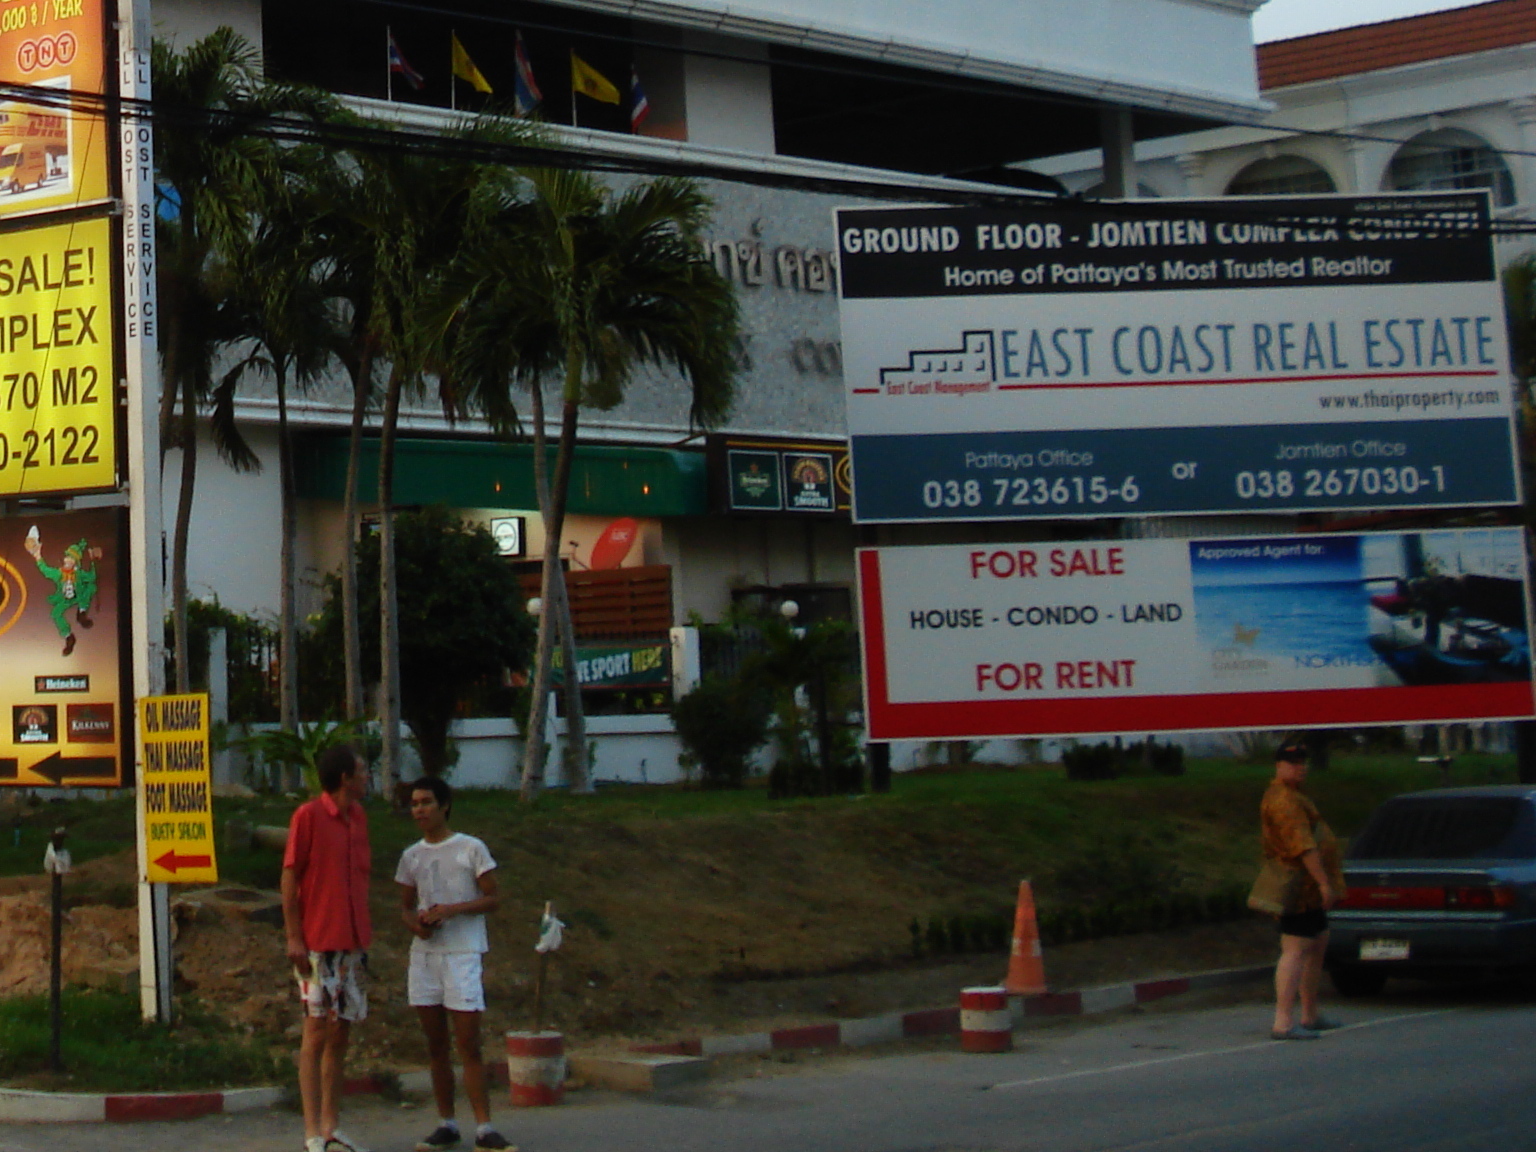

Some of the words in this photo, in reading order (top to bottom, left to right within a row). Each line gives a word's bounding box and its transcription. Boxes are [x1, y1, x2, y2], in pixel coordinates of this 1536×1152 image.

[21, 37, 73, 67] TNT
[843, 226, 960, 254] GROUND
[976, 223, 1063, 251] FLOOR
[1087, 219, 1208, 248] JOMTIEN
[1216, 215, 1340, 244] COMPLEX
[126, 204, 137, 338] SERVICE
[140, 204, 154, 337] SERVICE
[944, 265, 1014, 287] Home
[1021, 263, 1045, 285] of
[1050, 261, 1157, 287] Pattaya's
[1163, 259, 1217, 282] Most
[1223, 257, 1305, 280] Trusted
[1311, 255, 1393, 277] Realtor
[1002, 328, 1094, 379] EAST
[1113, 324, 1235, 375] COAST
[1252, 320, 1349, 372] REAL
[1363, 316, 1495, 368] ESTATE
[52, 365, 98, 407] M2
[887, 380, 905, 396] East
[1319, 388, 1500, 411] www.thaiproperty.com
[965, 451, 1034, 471] Pattaya
[1037, 448, 1094, 468] Office
[1275, 442, 1348, 461] Jomtien
[1351, 439, 1407, 458] Office
[922, 479, 982, 509] 038
[992, 475, 1140, 506] 723615-6
[1171, 461, 1198, 480] or
[1235, 470, 1295, 499] 038
[1304, 465, 1446, 498] 267030-1
[970, 550, 1038, 579] FOR
[1049, 548, 1126, 578] SALE
[1198, 546, 1260, 561] Approved
[1264, 544, 1302, 560] Agent
[910, 608, 984, 630] HOUSE
[1007, 605, 1099, 627] CONDO
[1121, 603, 1183, 624] LAND
[591, 652, 631, 681] SPORT
[976, 663, 1044, 692] FOR
[1056, 659, 1137, 690] RENT
[46, 677, 87, 690] Heineken
[71, 719, 110, 731] KILKENNY
[146, 702, 159, 733] OIL
[162, 700, 201, 732] MASSAGE
[145, 742, 163, 773] THAI
[165, 740, 205, 772] MASSAGE
[146, 782, 166, 814] FOOT
[168, 781, 208, 813] MASSAGE
